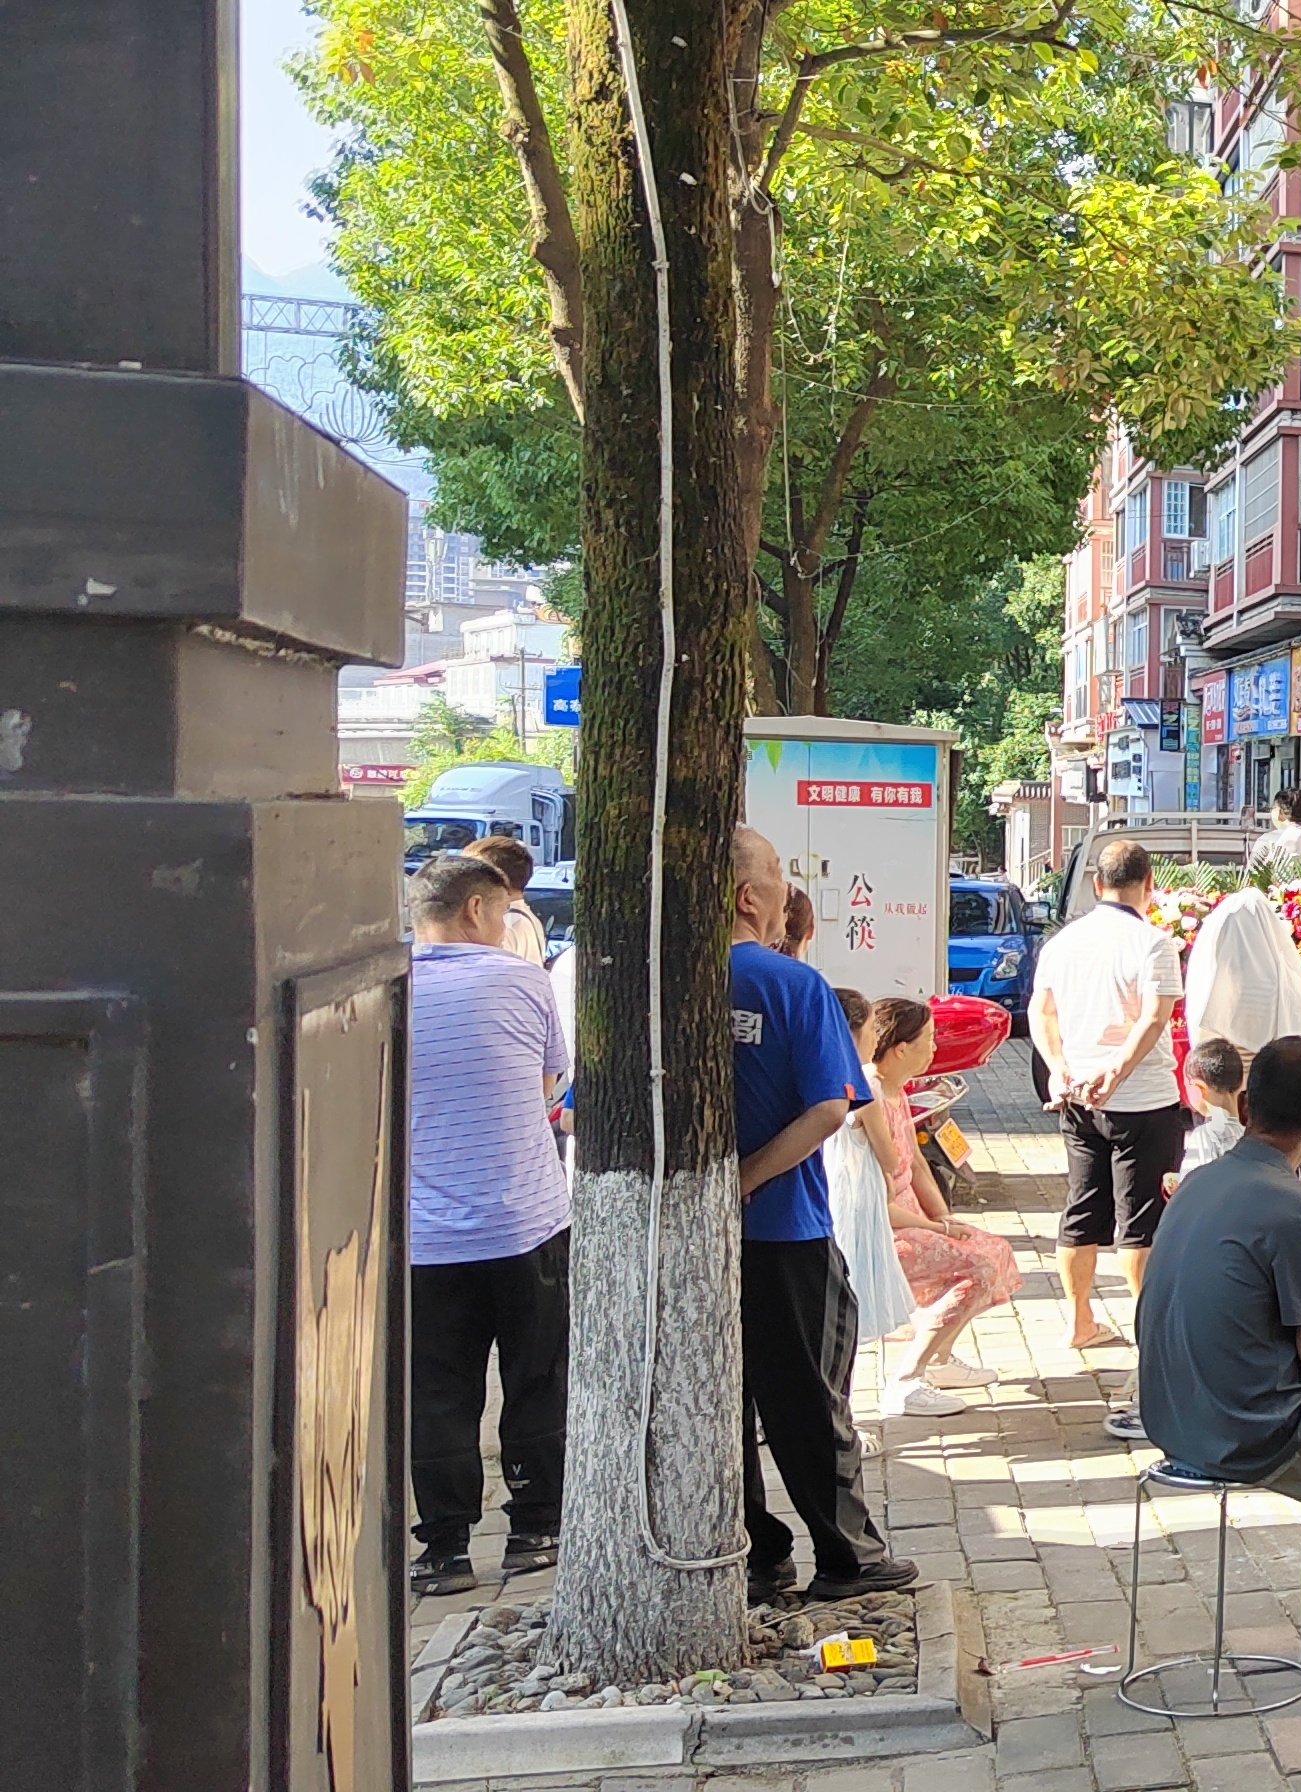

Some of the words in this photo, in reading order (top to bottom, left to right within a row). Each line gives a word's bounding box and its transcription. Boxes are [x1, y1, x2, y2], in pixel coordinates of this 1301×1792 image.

[806, 784, 862, 803] 文明健康
[869, 785, 924, 805] 有你有我
[846, 872, 877, 952] 公筷
[883, 902, 928, 917] 从我做起
